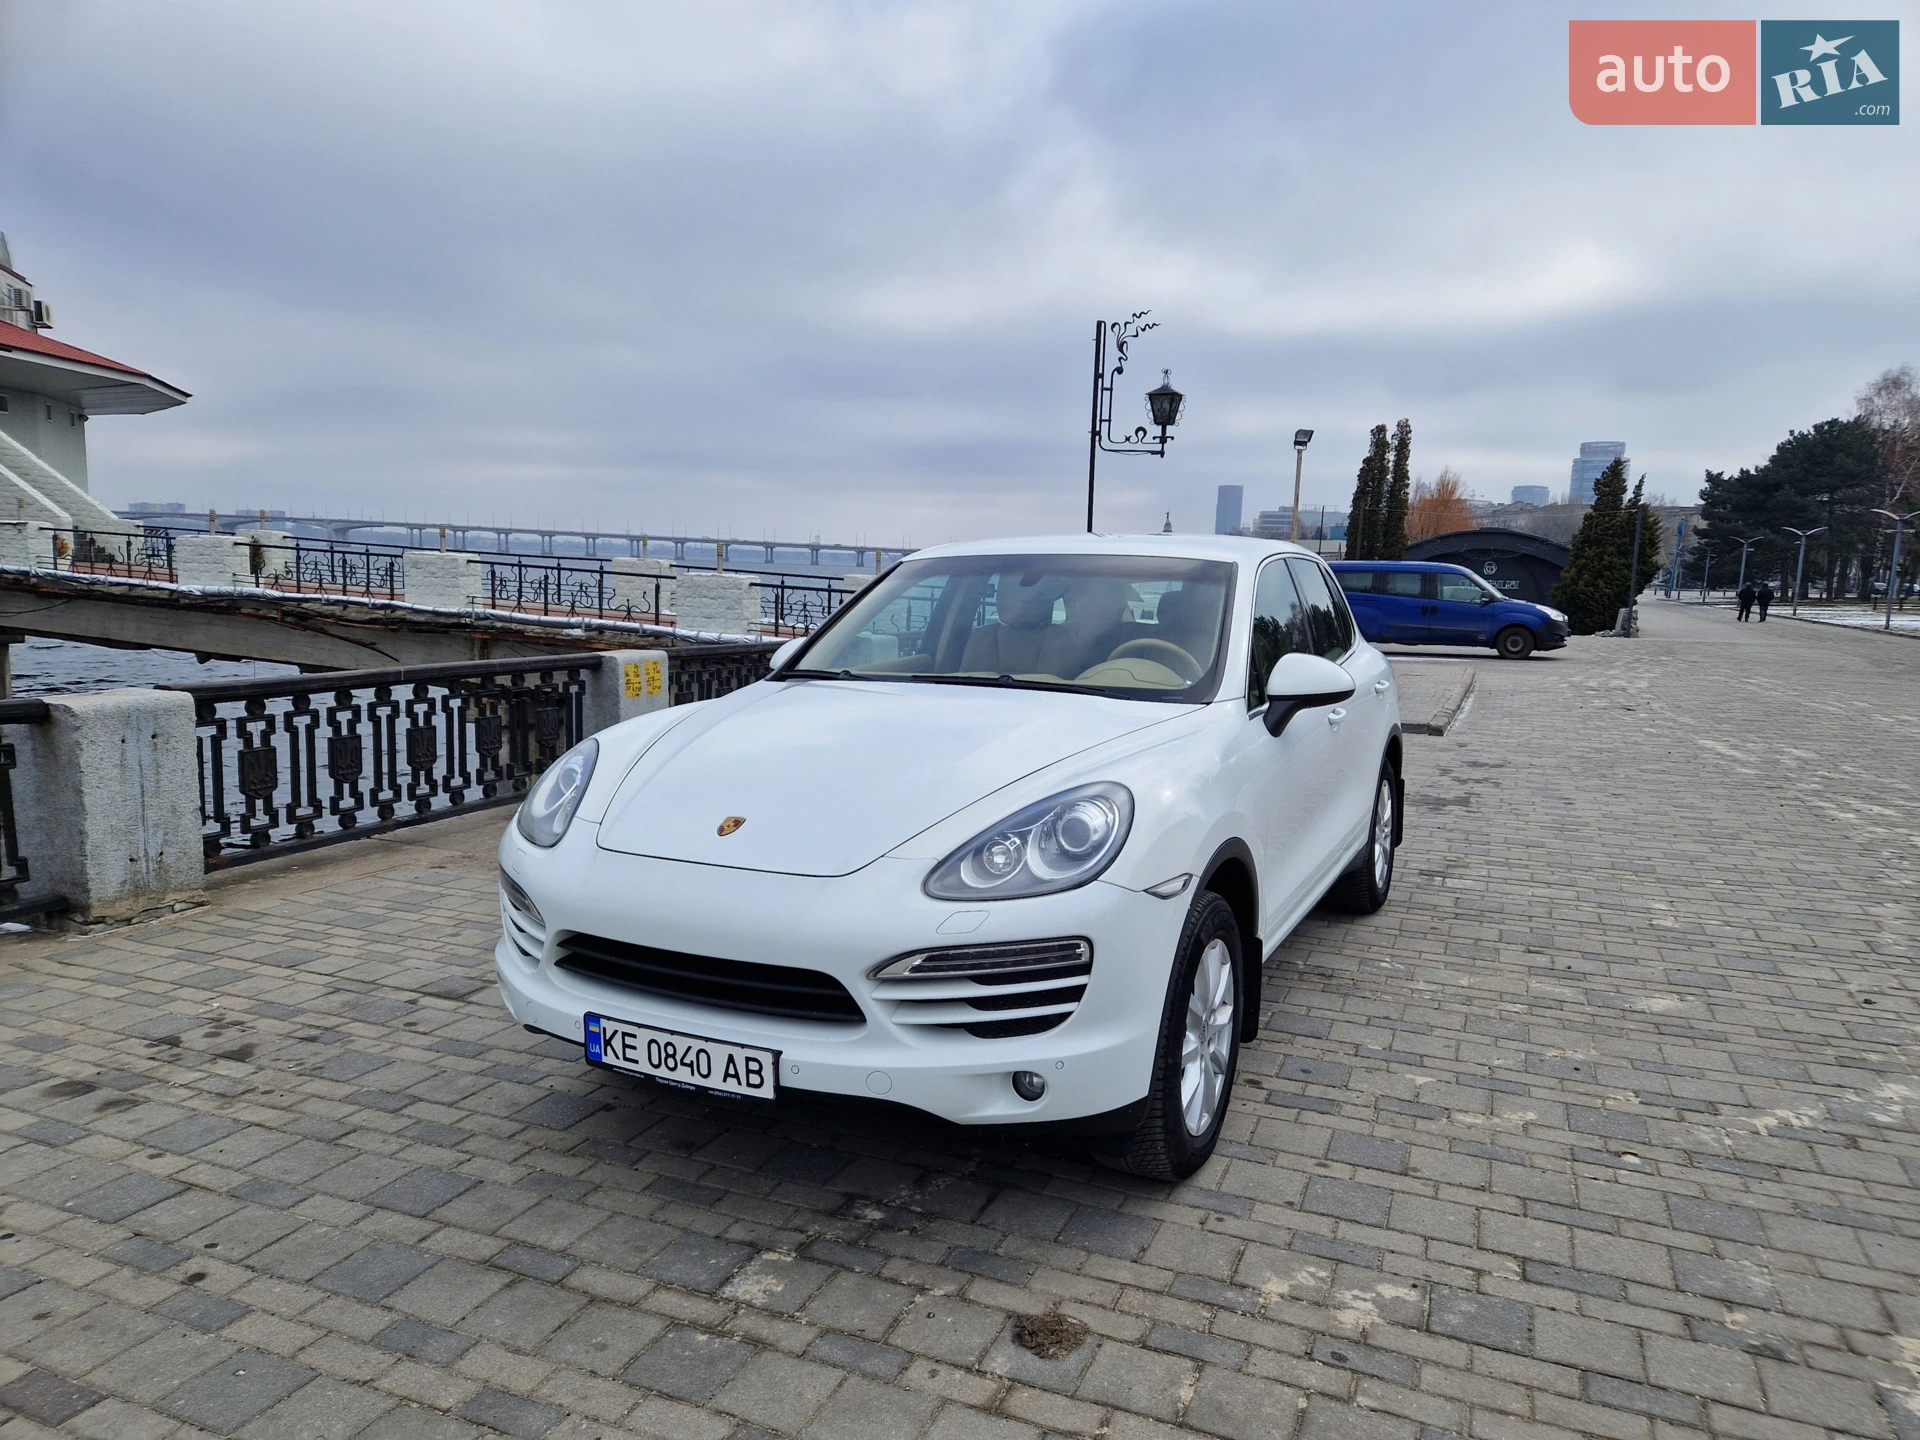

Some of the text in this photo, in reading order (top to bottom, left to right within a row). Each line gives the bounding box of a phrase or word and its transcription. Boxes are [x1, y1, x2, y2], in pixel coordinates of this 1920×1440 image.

[589, 1042, 601, 1054] UA
[602, 1026, 765, 1089] KE 0840 AB
